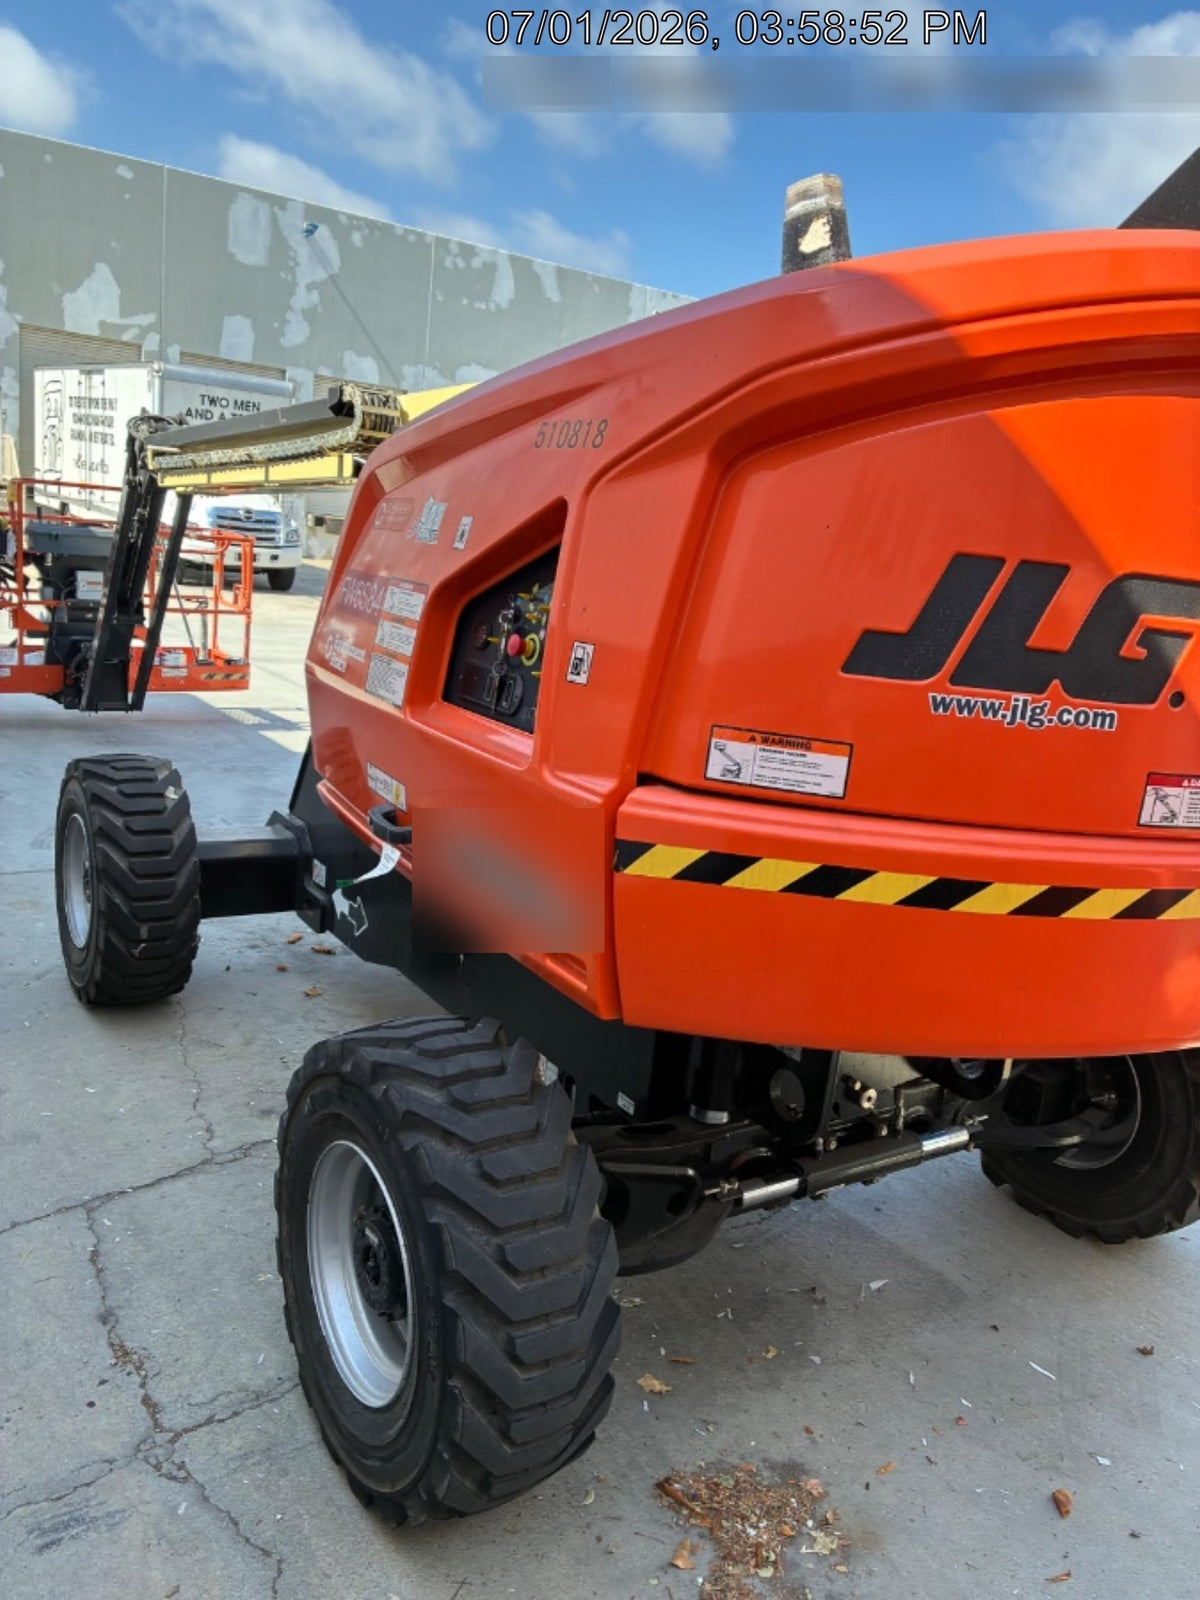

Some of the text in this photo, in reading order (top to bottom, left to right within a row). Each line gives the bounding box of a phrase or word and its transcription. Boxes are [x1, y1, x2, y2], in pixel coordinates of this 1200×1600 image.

[185, 406, 214, 420] AND
[199, 394, 261, 412] TWO MEN
[534, 418, 608, 449] 510818
[841, 553, 1200, 705] JLG
[929, 693, 1117, 731] www.jlg.com
[760, 735, 812, 752] WARNING
